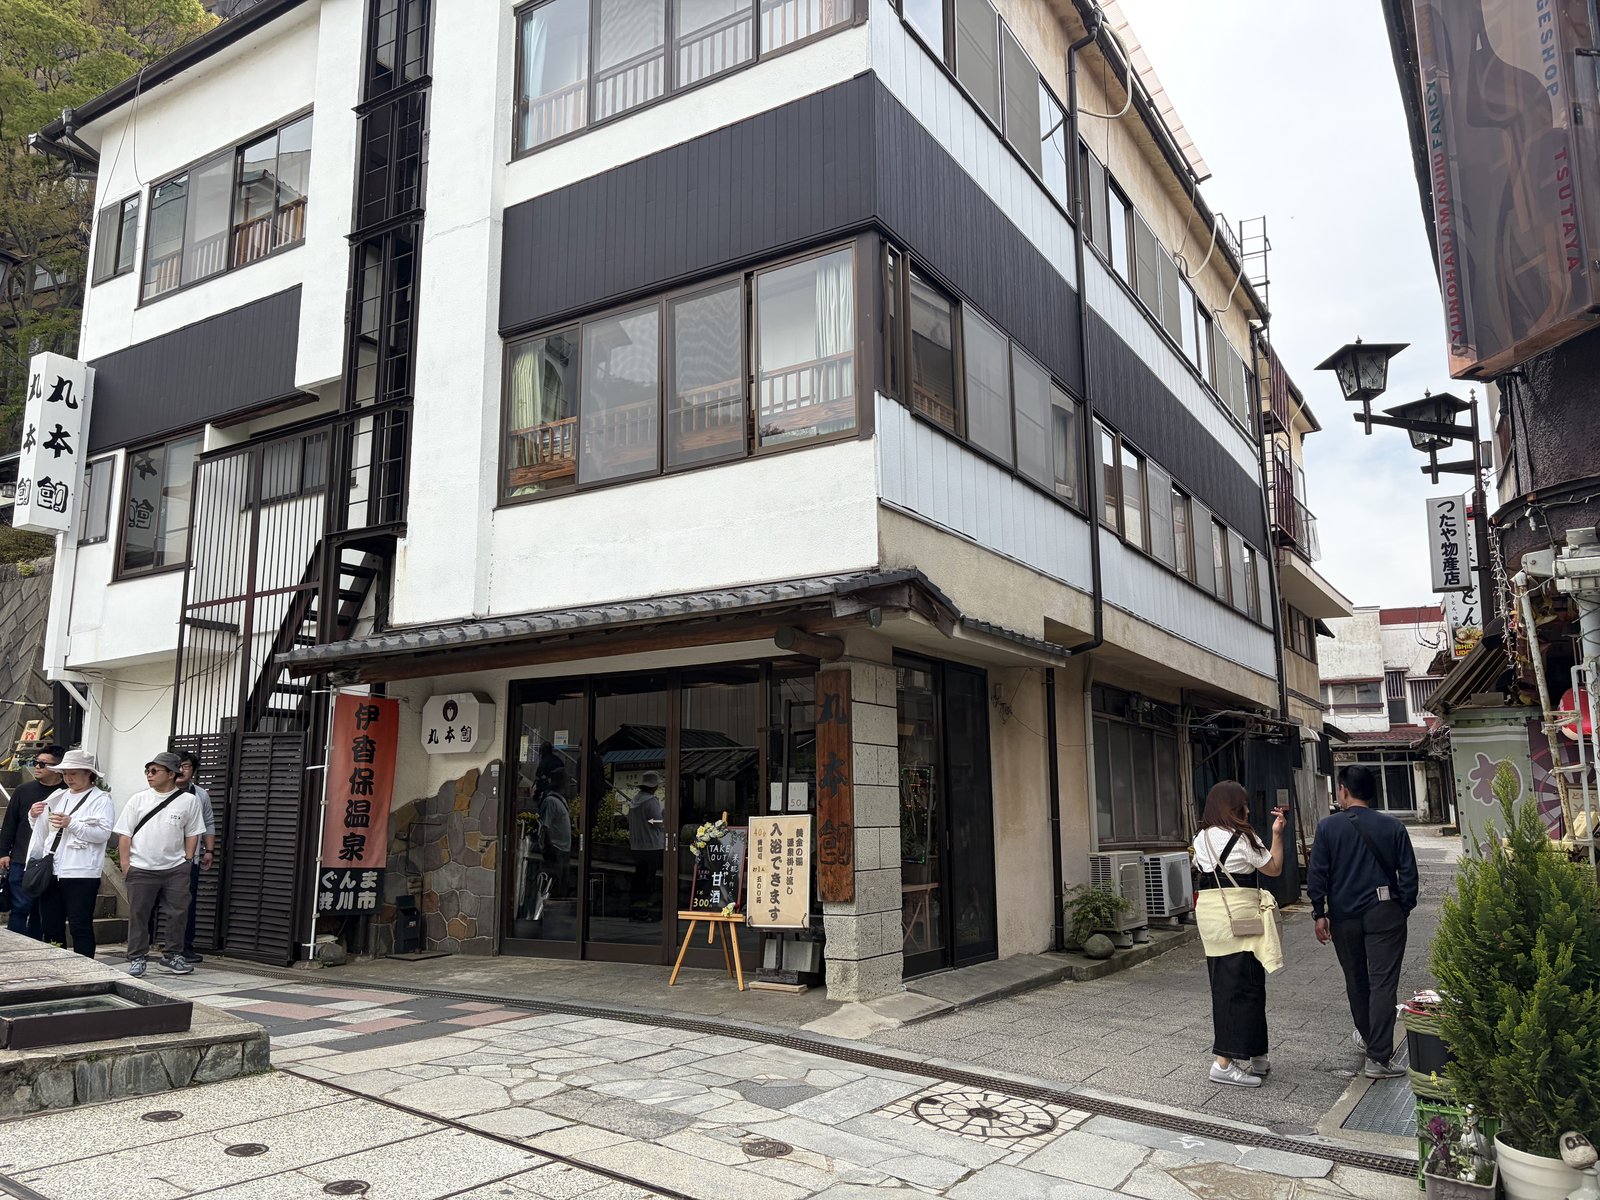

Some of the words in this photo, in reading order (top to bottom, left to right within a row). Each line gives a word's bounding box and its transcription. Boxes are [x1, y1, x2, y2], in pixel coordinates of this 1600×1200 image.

[1425, 80, 1444, 149] FANCY
[1553, 147, 1584, 272] TSUTAYA
[1436, 500, 1460, 586] つたや物産店
[338, 702, 380, 862] 伊香保温泉
[709, 844, 731, 853] TAKE
[710, 853, 727, 861] OUT
[722, 861, 731, 886] 冷やし
[768, 822, 783, 922] 入浴できます
[321, 870, 378, 889] ぐんま
[709, 871, 723, 904] 甘酒
